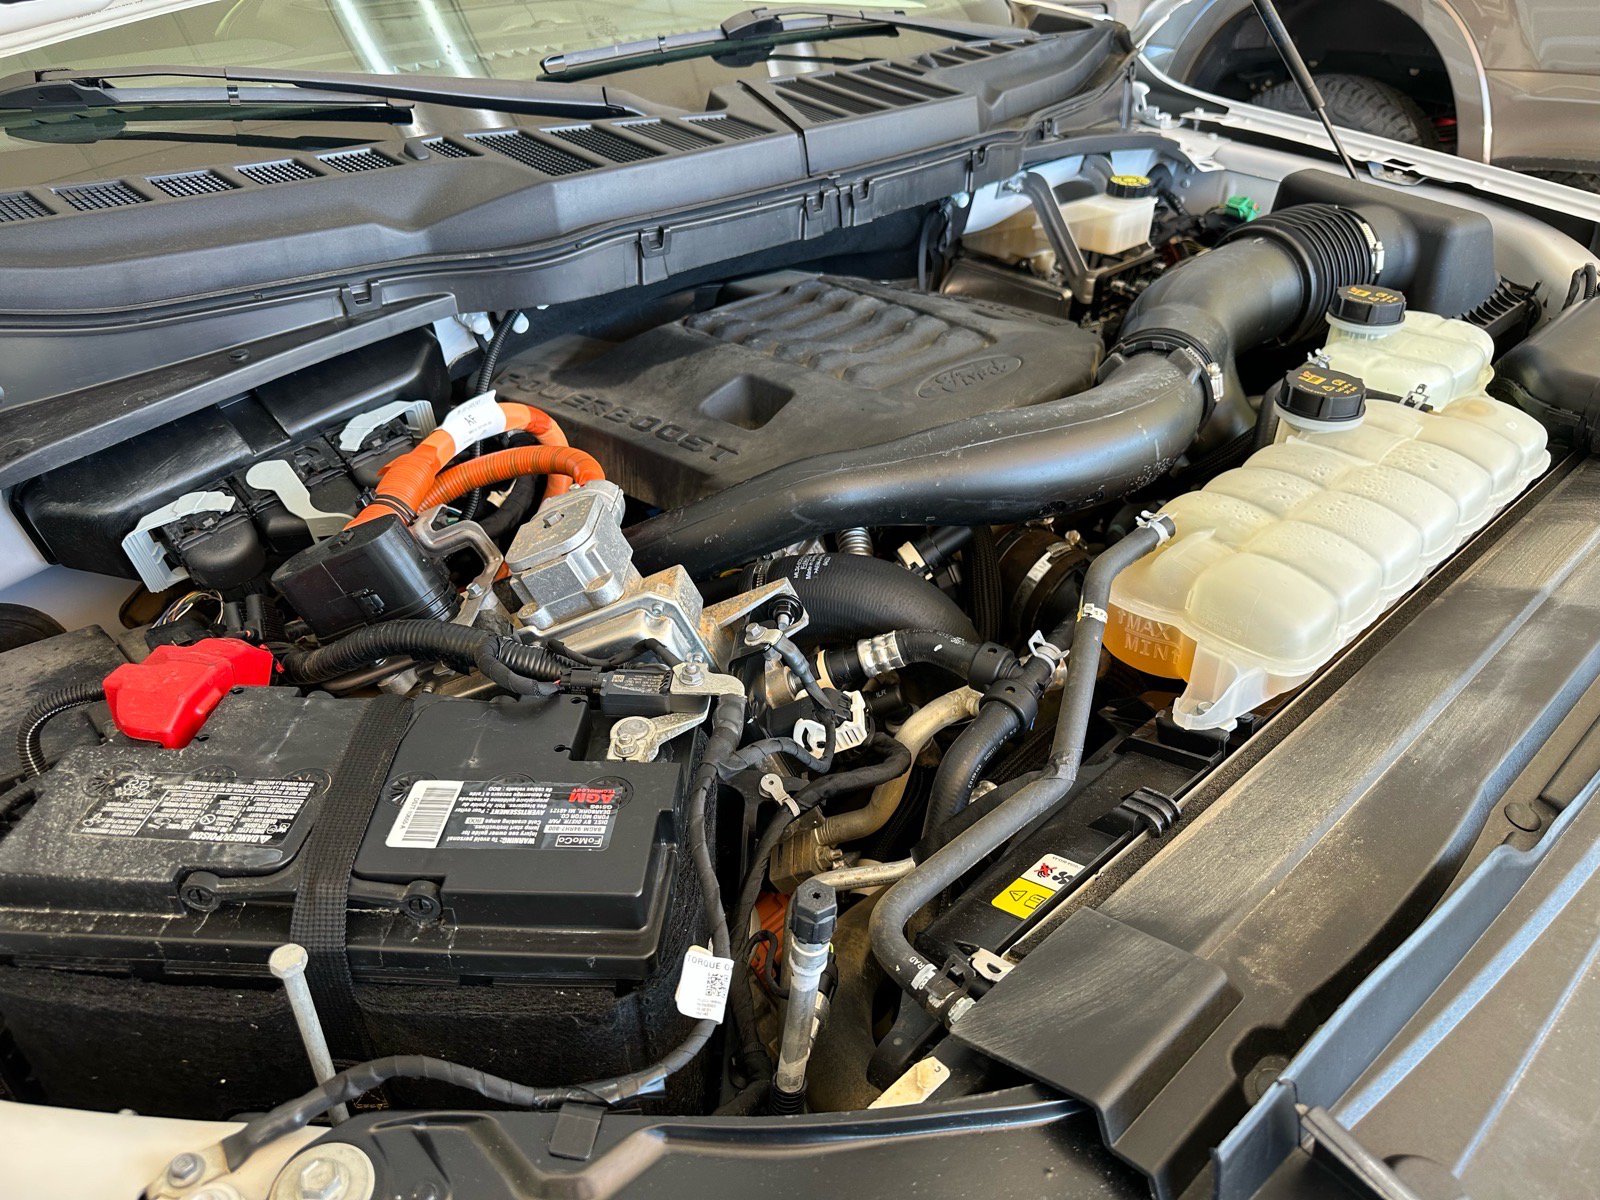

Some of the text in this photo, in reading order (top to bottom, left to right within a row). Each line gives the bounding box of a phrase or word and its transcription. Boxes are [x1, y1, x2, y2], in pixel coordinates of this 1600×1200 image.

[935, 357, 1007, 393] Ford
[496, 372, 740, 463] POWERBOOST
[1126, 612, 1172, 641] MAX
[1124, 633, 1169, 661] MIN
[568, 793, 614, 803] AGM
[188, 832, 260, 843] DANGER/POISON
[557, 837, 601, 845] FoMoCo
[686, 954, 721, 970] TORQUE
[909, 956, 925, 970] RAD
